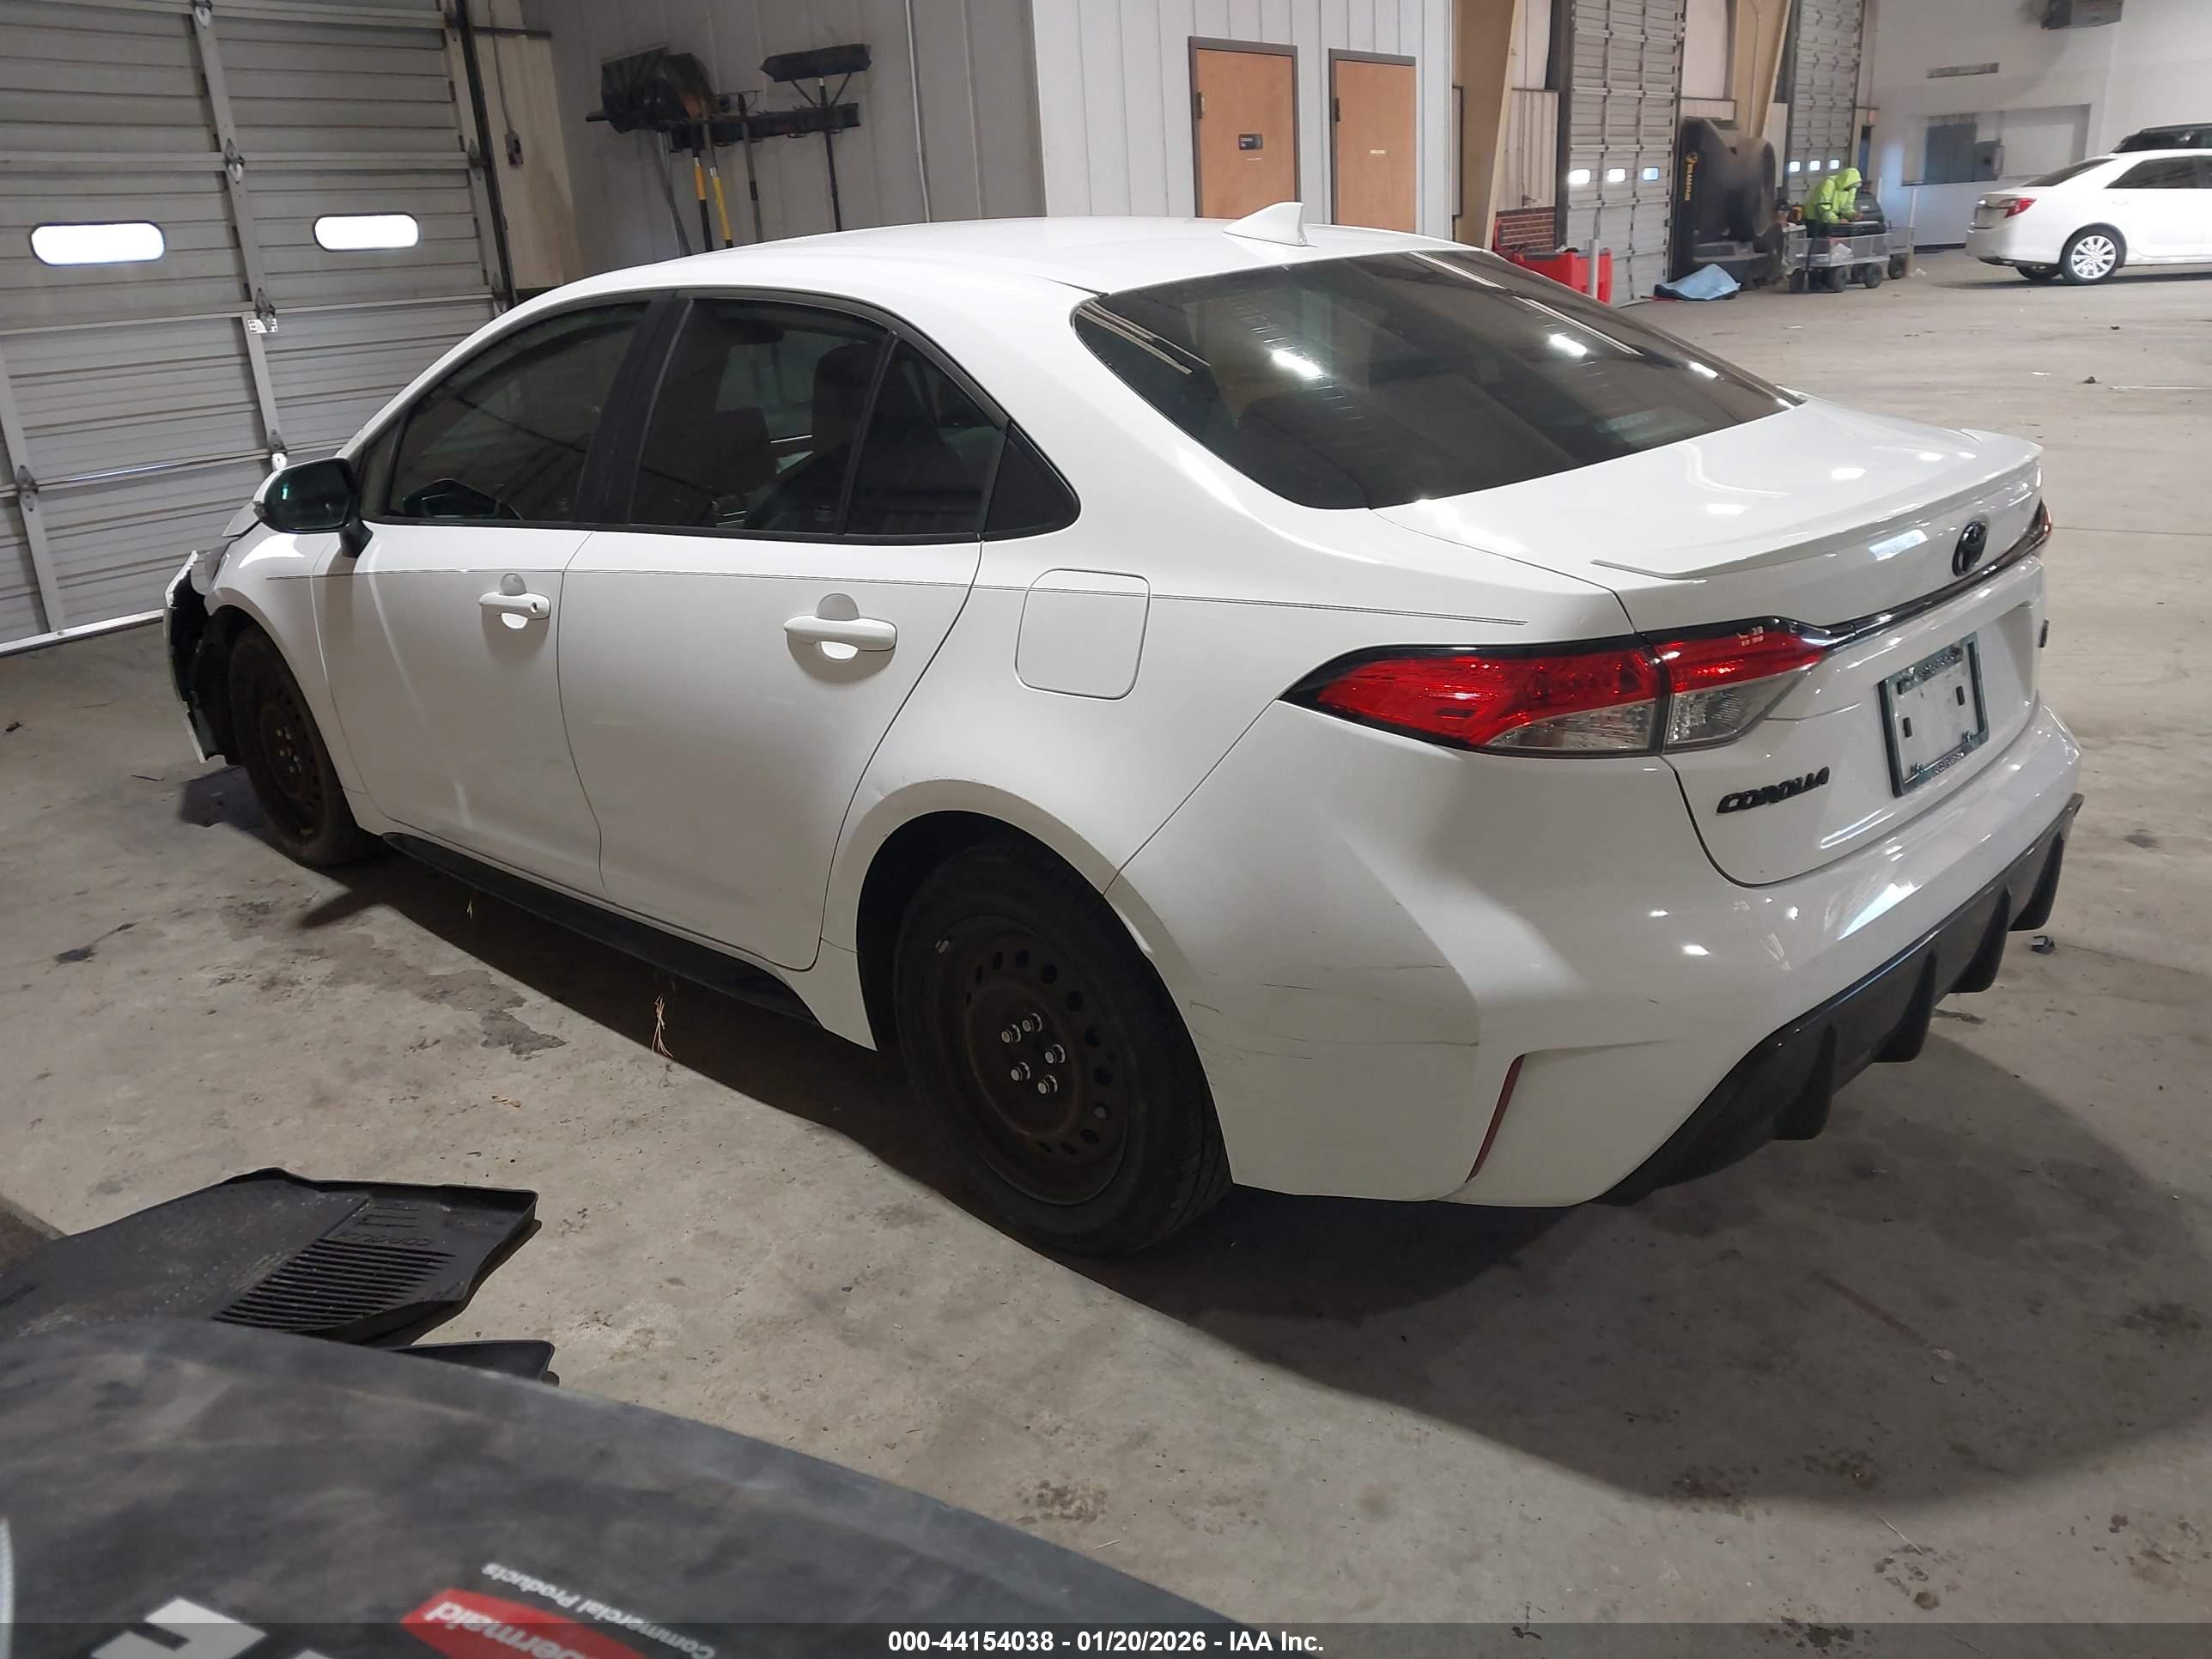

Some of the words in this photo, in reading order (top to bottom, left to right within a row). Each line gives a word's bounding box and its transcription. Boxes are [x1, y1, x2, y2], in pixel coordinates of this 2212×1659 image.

[1717, 767, 1831, 814] COROLLA
[481, 1562, 581, 1609] Products
[575, 1597, 715, 1659] Commercial
